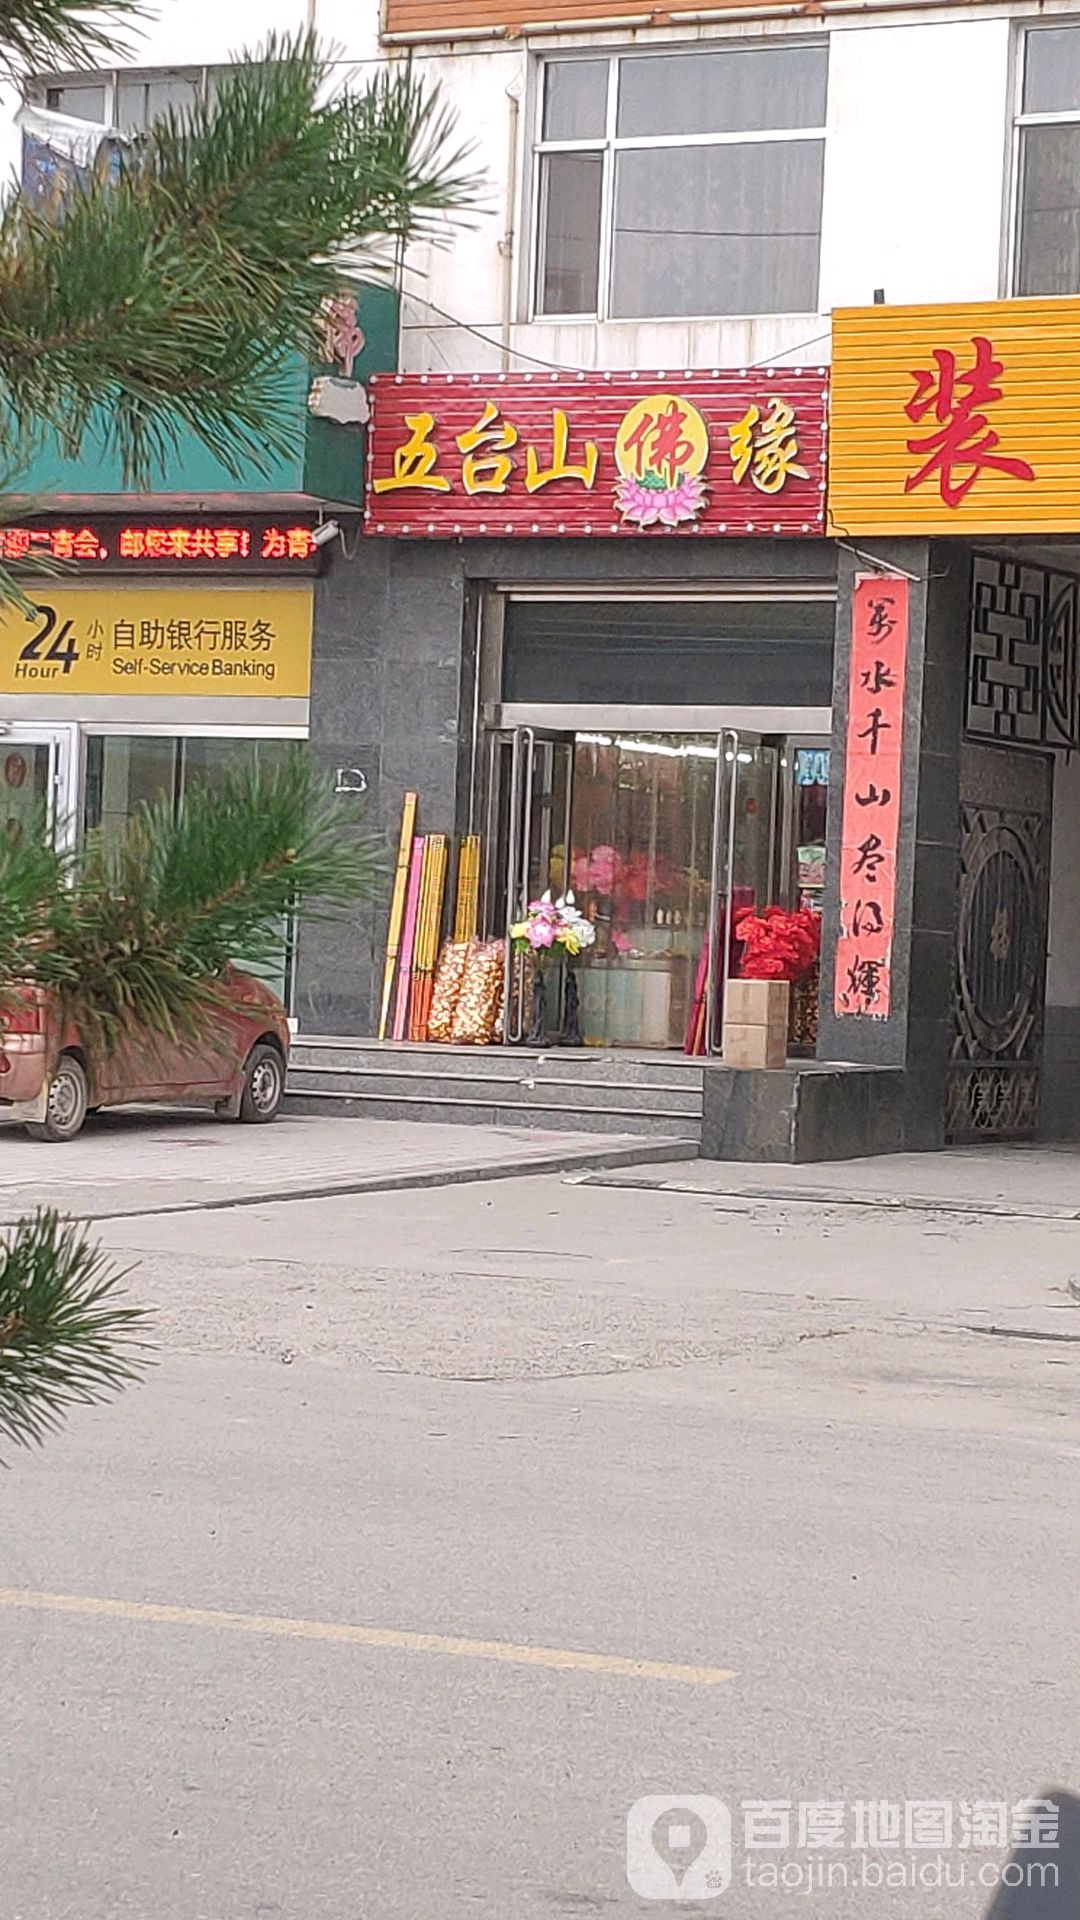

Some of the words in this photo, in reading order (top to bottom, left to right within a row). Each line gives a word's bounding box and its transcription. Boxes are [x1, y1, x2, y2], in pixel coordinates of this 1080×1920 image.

[905, 337, 1035, 509] 装
[373, 398, 810, 495] 五台山佛缘
[19, 606, 80, 673] 24
[86, 619, 103, 661] 小时
[113, 619, 276, 651] 自助银行服务
[15, 663, 59, 678] Hour
[112, 657, 209, 676] Self-Service
[211, 658, 276, 680] Banking
